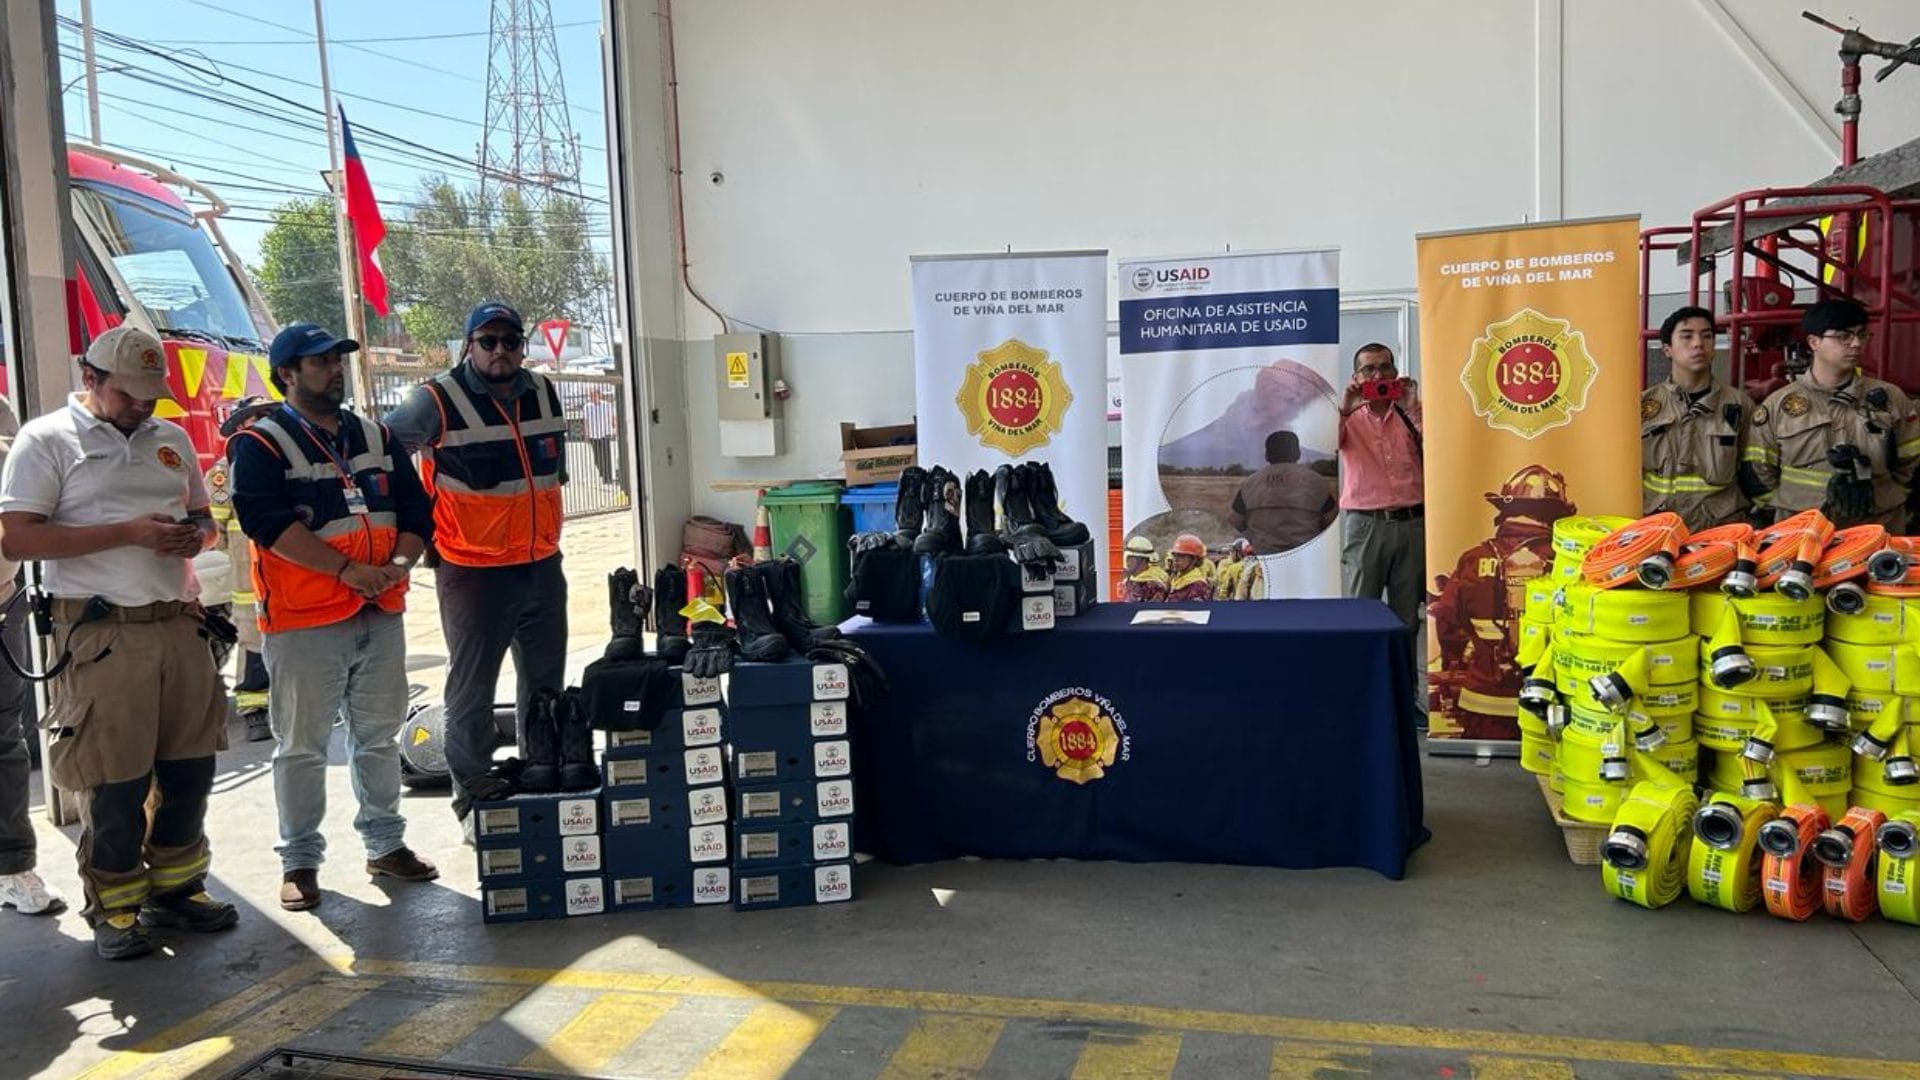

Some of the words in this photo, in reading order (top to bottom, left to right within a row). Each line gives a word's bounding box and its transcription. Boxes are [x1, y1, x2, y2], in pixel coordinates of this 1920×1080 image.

[1440, 261, 1500, 275] CUERPO
[1505, 258, 1526, 270] DE
[1529, 251, 1615, 268] BOMBEROS
[1156, 267, 1211, 283] USAID
[1461, 277, 1481, 289] DE
[1485, 272, 1521, 286] VIÑA
[1526, 271, 1555, 283] DEL
[1559, 268, 1593, 281] MAR
[935, 291, 987, 303] CUERPO
[991, 290, 1007, 301] DE
[1011, 288, 1083, 301] BOMBEROS
[953, 305, 970, 316] DE
[974, 303, 1005, 315] VIÑA
[1008, 304, 1033, 314] DEL
[1036, 303, 1065, 314] MAR
[1144, 307, 1202, 322] OFICINA
[1206, 304, 1225, 317] DE
[1226, 300, 1308, 316] ASISTENCIA
[1140, 321, 1237, 339] HUMANITARIA
[1241, 320, 1260, 333] DE
[1264, 318, 1308, 332] USAID
[1498, 335, 1558, 354] BOMBEROS
[988, 362, 1041, 379] BOMBEROS
[1502, 360, 1560, 385] 1884
[992, 387, 1041, 410] 1884
[1520, 404, 1540, 414] DEL
[1540, 393, 1562, 411] MAR
[1007, 428, 1024, 436] DEL
[1024, 418, 1042, 434] MAR
[686, 685, 717, 696] USAID
[816, 682, 846, 691] USAID
[814, 718, 843, 727] USAID
[1026, 715, 1038, 762] CUERPO
[1033, 686, 1093, 716] BOMBEROS
[1121, 735, 1131, 762] MAR
[687, 726, 717, 736] USAID
[1061, 731, 1097, 752] 1884
[818, 758, 847, 768] USAID
[689, 765, 719, 775] USAID
[821, 797, 850, 807] USAID
[694, 804, 723, 815] USAID
[562, 816, 593, 826] USAID
[694, 842, 723, 852] USAID
[817, 841, 846, 850] USAID
[567, 852, 597, 862] USAID
[697, 885, 726, 894] USAID
[819, 881, 848, 892] USAID
